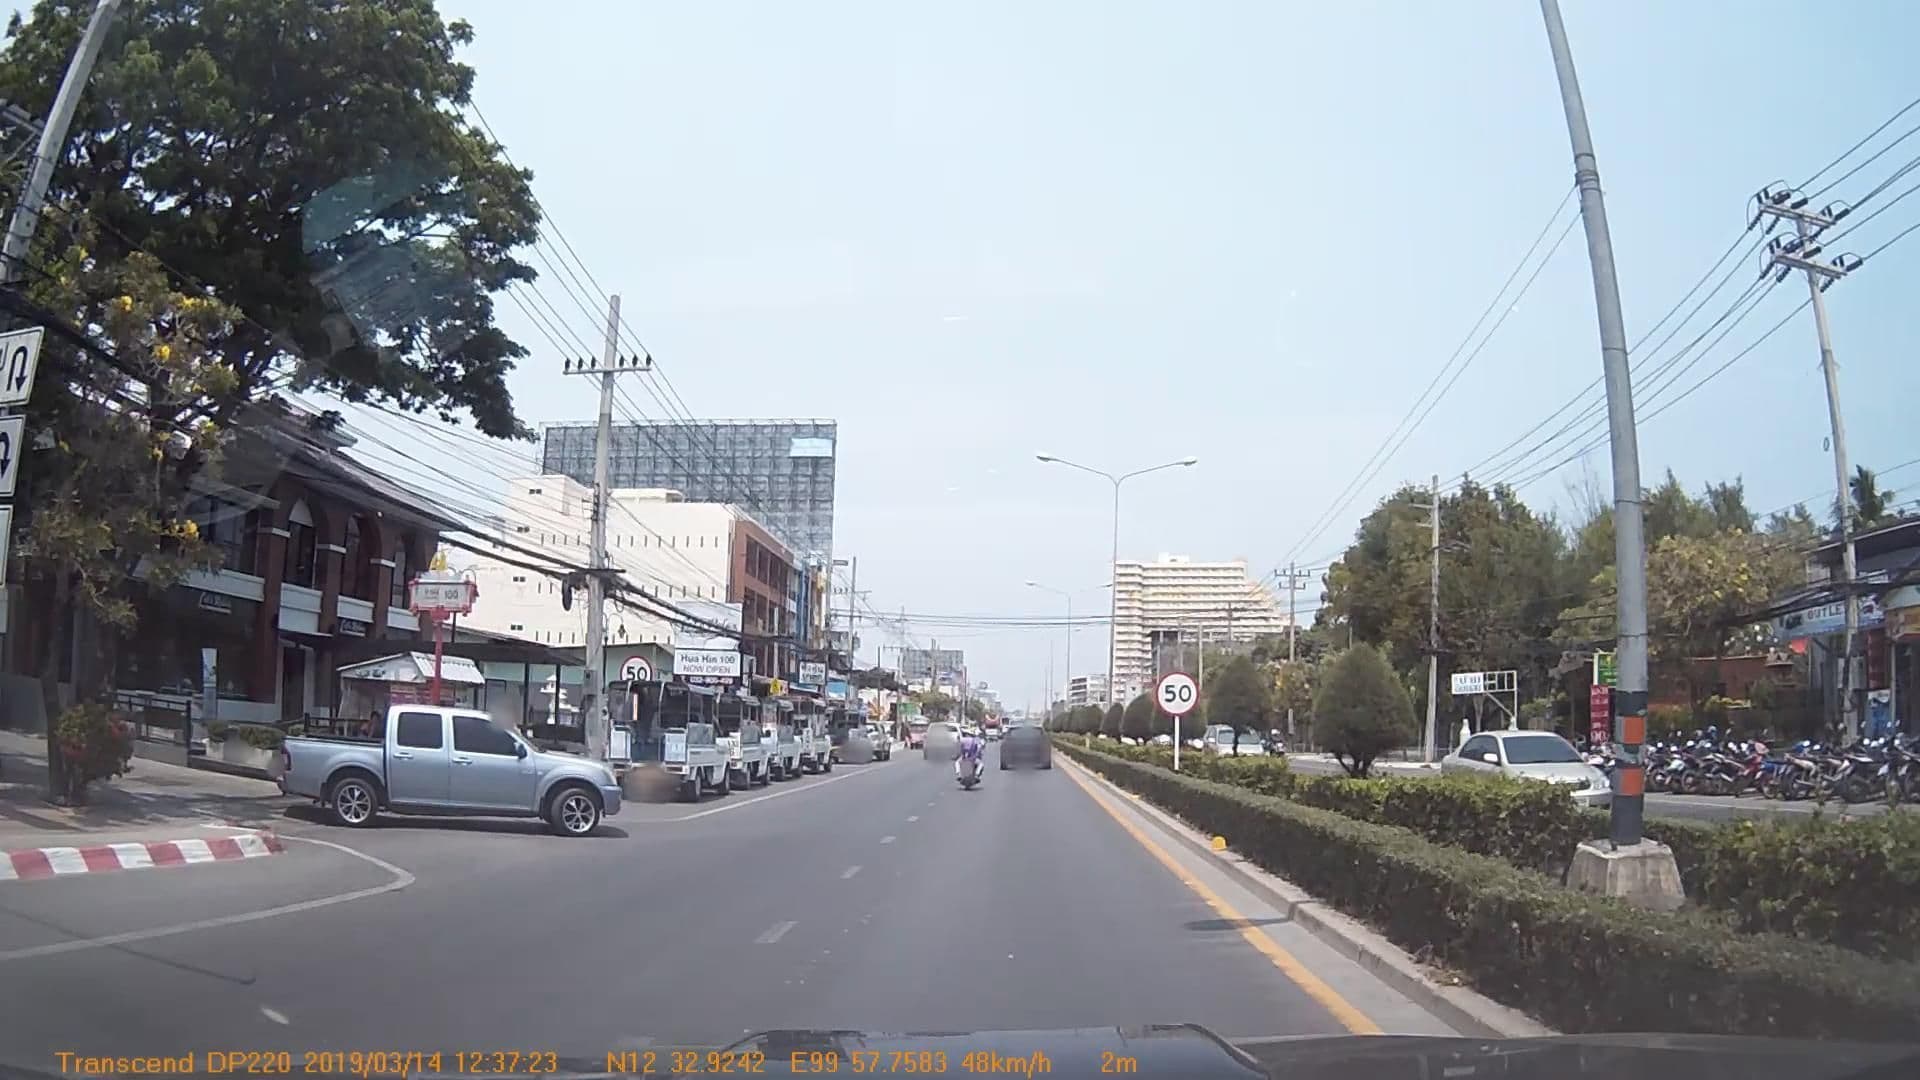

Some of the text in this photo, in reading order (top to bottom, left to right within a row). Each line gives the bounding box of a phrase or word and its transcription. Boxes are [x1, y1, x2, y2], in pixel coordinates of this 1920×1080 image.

[1807, 603, 1846, 620] OUTLE
[681, 654, 735, 664] Hua Hin 100
[627, 666, 647, 681] 50
[683, 664, 731, 674] NOW OPEN
[1165, 684, 1191, 703] 50
